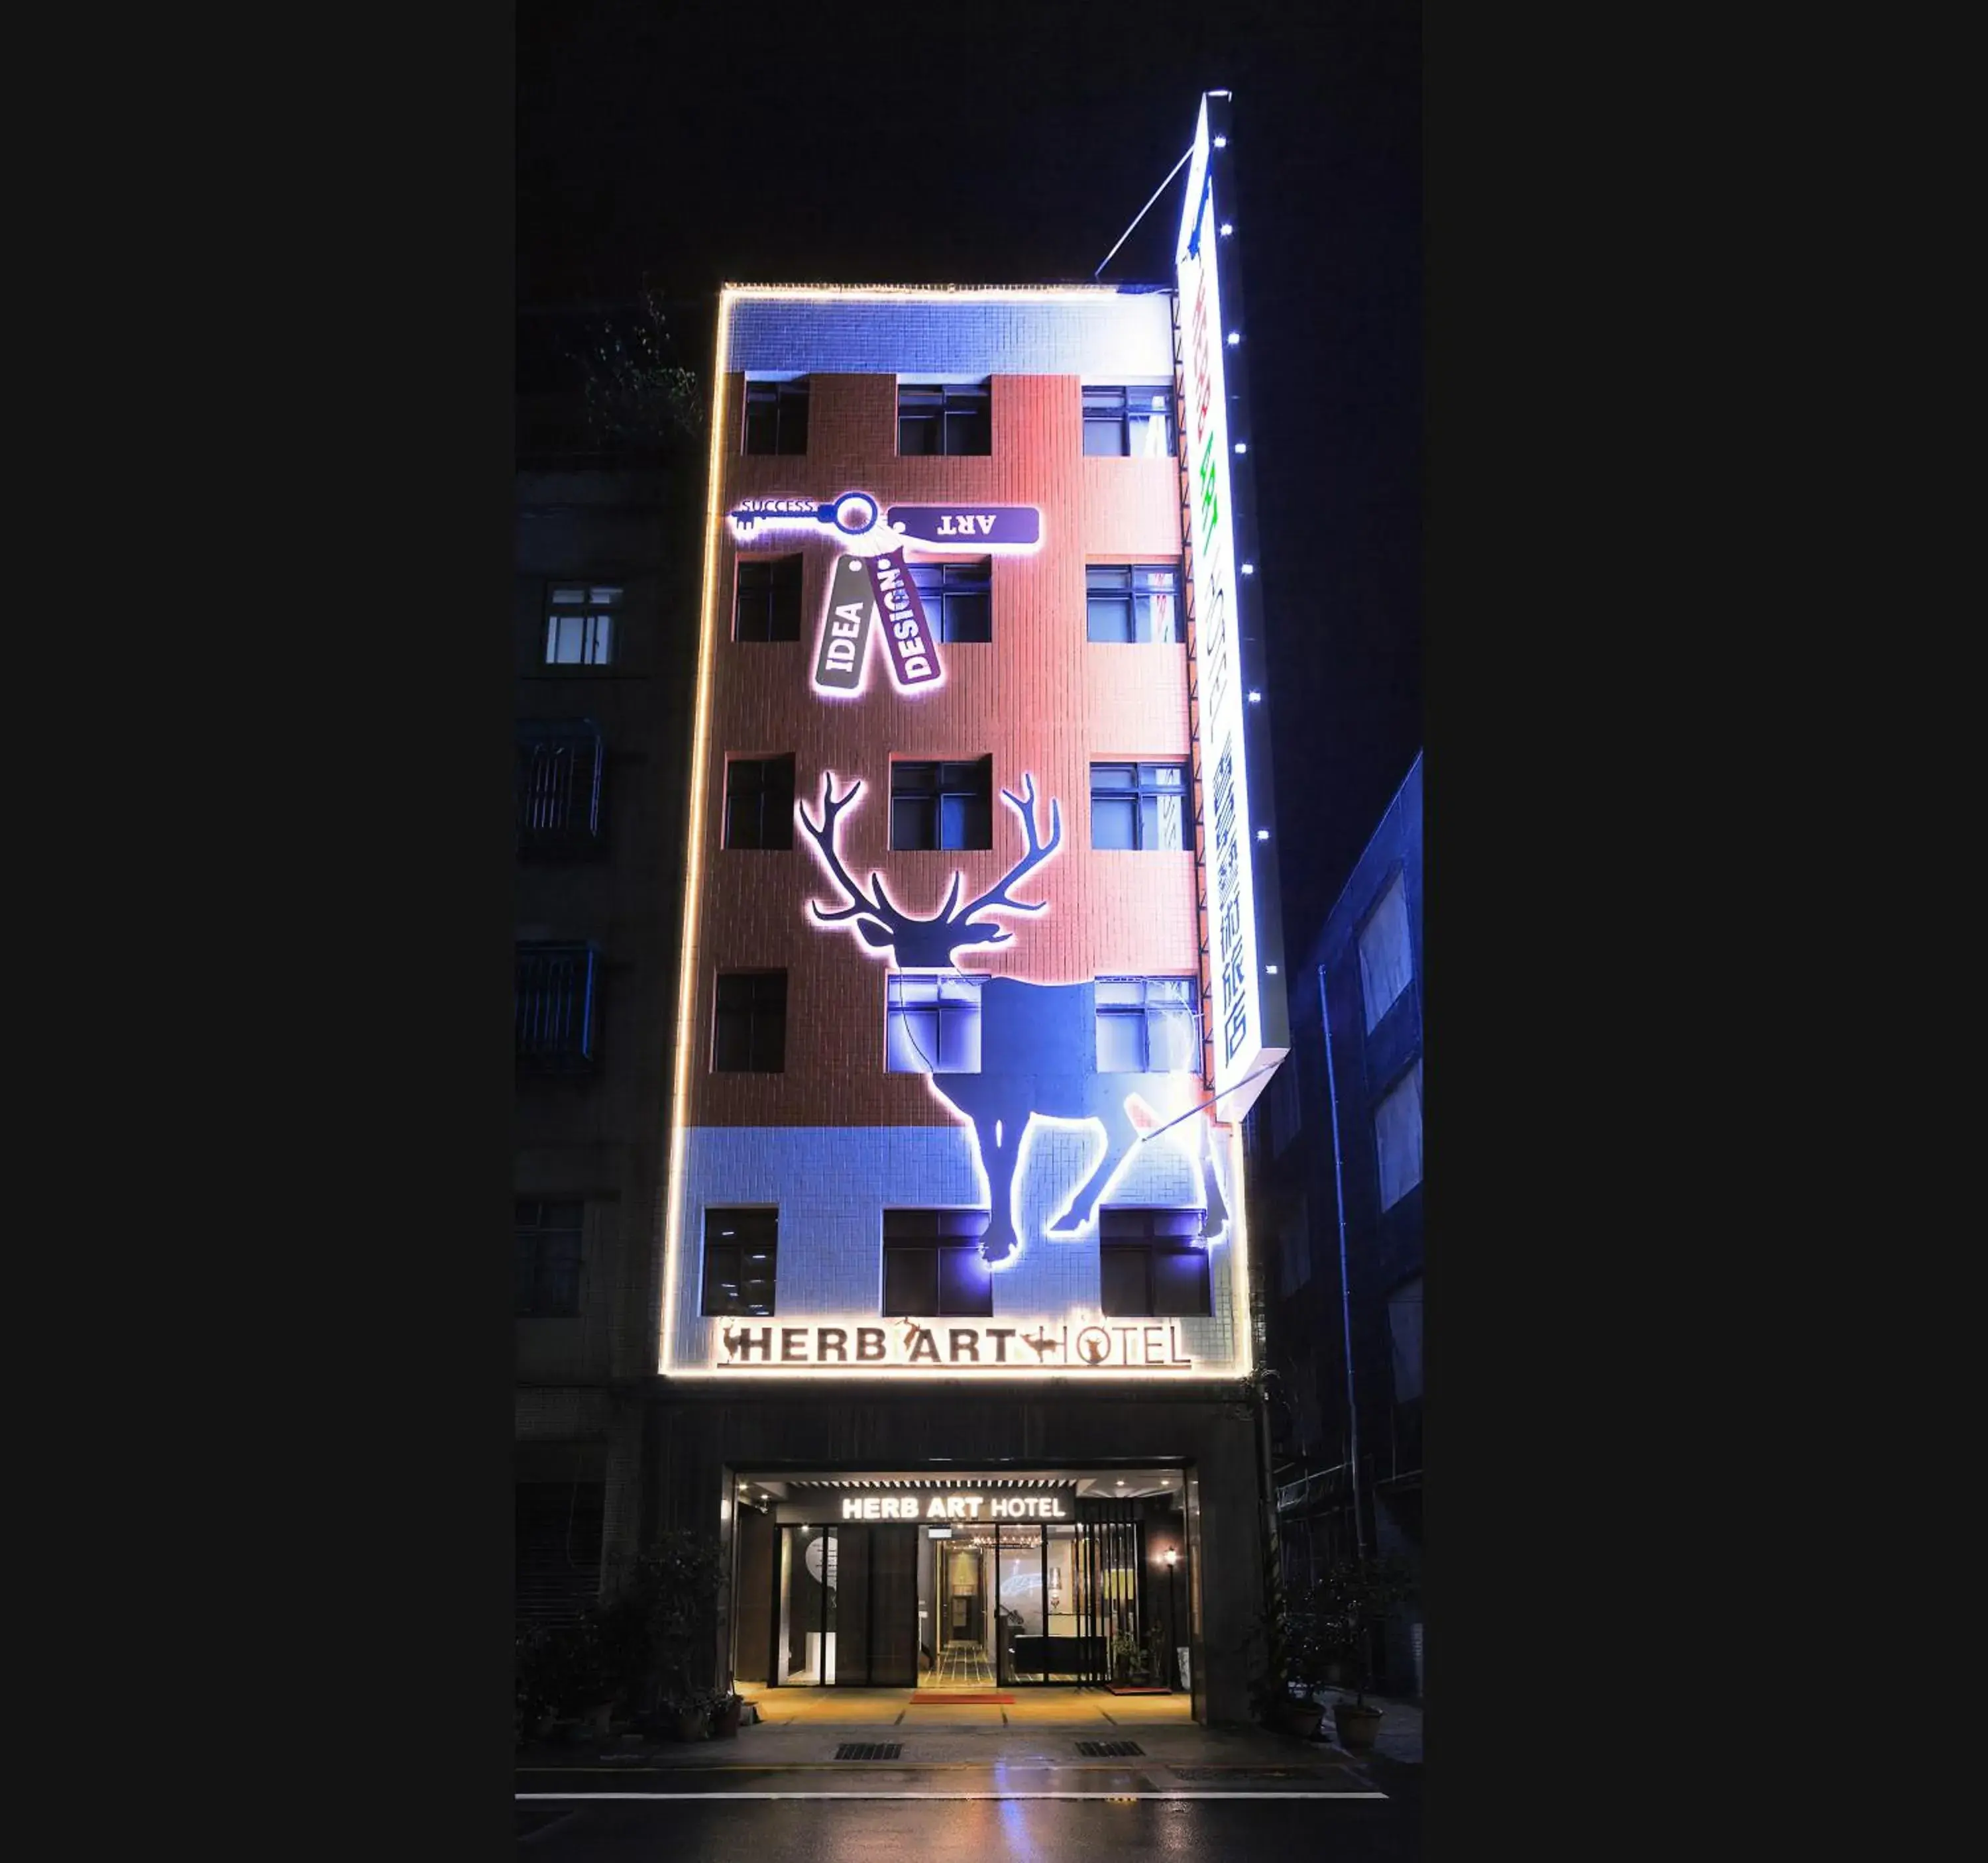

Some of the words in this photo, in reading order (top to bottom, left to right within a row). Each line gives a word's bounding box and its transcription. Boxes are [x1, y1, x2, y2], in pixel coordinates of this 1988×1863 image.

[1192, 268, 1211, 443] HERB
[742, 500, 814, 512] SUCCESS
[937, 514, 997, 535] ART
[1200, 430, 1219, 557] ART
[826, 602, 864, 672] IDEA
[877, 567, 932, 679] DESIGN
[1205, 543, 1228, 744] HOTEL
[740, 1327, 887, 1361] HERB
[909, 1328, 1015, 1362] ART
[1038, 1325, 1191, 1365] HOTEL
[842, 1497, 919, 1518] HERB
[927, 1497, 983, 1518] ART
[991, 1498, 1066, 1517] HOTEL
